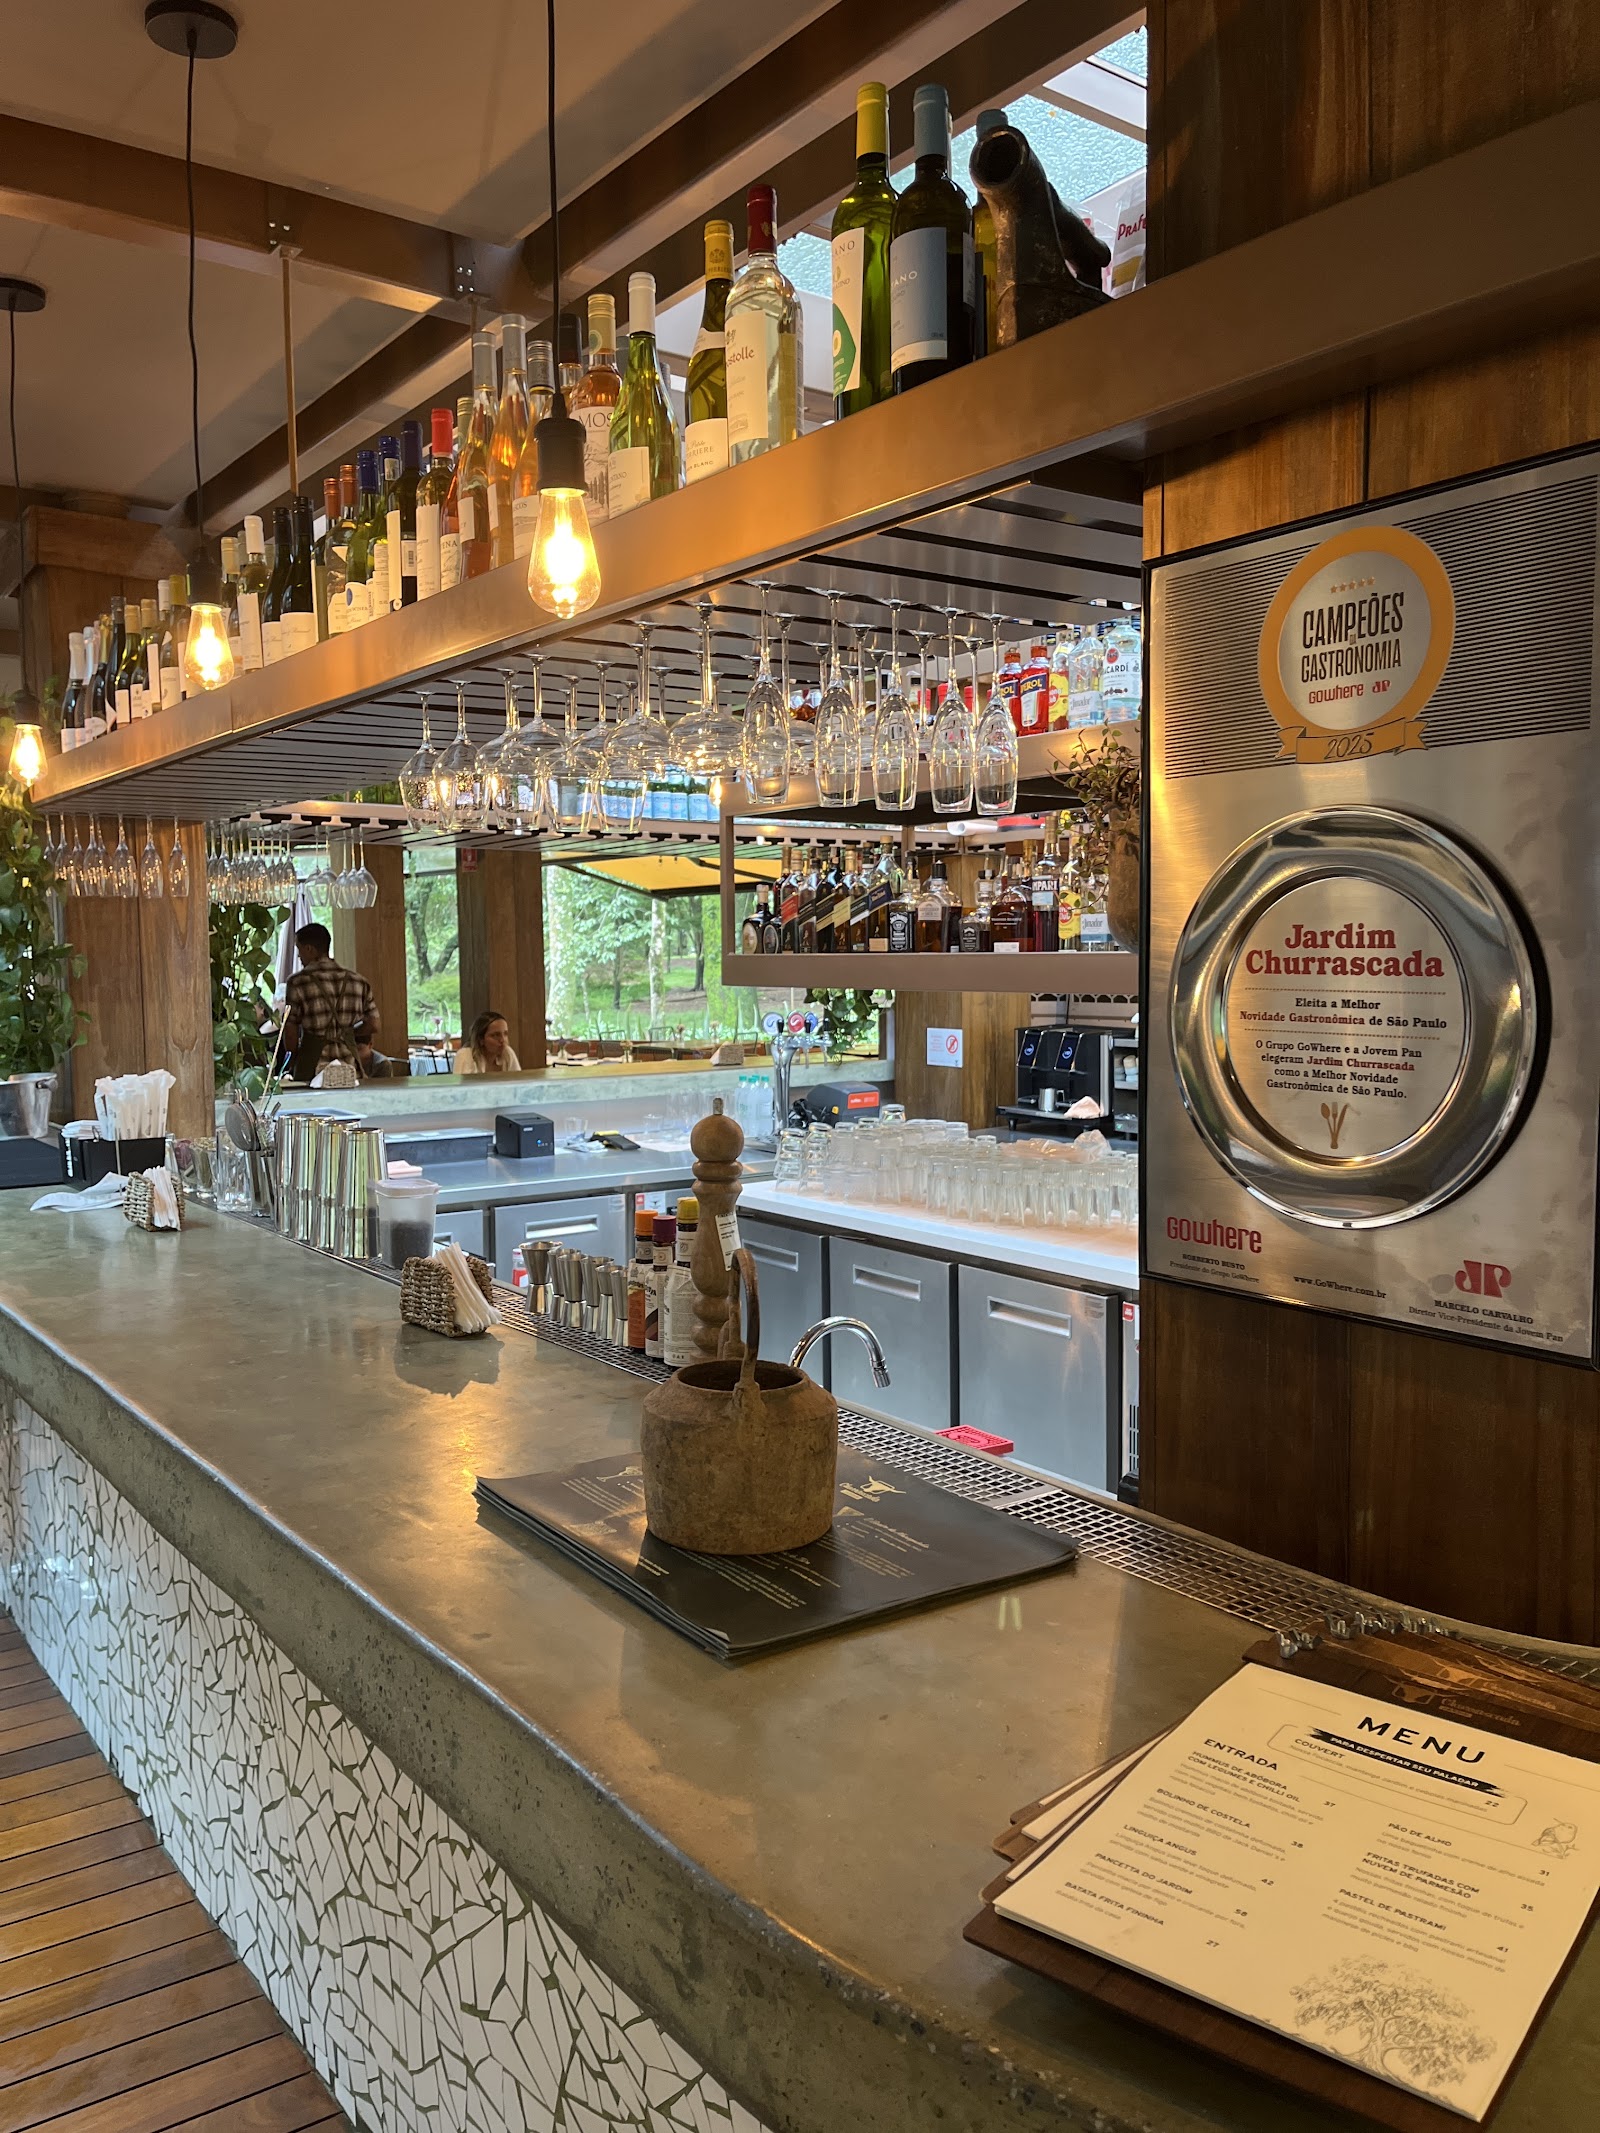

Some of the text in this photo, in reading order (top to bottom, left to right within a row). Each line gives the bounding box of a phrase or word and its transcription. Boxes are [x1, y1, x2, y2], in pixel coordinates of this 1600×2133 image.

[1302, 592, 1405, 649] CAMPEÕES
[1302, 639, 1402, 682] GASTRONOMIA
[1324, 732, 1375, 760] 2025
[1285, 923, 1396, 949] Jardim
[1246, 950, 1444, 976] Churrascada
[1295, 998, 1381, 1010] Eleita a Melhor
[1240, 1010, 1447, 1029] Novidade Gastronômica de São Paulo
[1256, 1040, 1263, 1048] O
[1266, 1040, 1294, 1051] Grupo
[1297, 1042, 1341, 1053] GoWhere
[1362, 1046, 1398, 1057] Jovem
[1402, 1048, 1422, 1058] Pan
[1261, 1054, 1415, 1071] elegeram Jardim Churrascada
[1266, 1079, 1407, 1098] Gastronômica de São Paulo.
[1274, 1069, 1300, 1077] como
[1312, 1069, 1346, 1080] Melhor
[1350, 1072, 1399, 1084] Novidade
[1221, 1260, 1246, 1270] BUSTO
[1293, 1276, 1387, 1299] www.GoWhere.com.br
[1409, 1306, 1564, 1342] Diretor Vice-Presidente da Jovem Pan
[1434, 1300, 1534, 1325] MARCELO CARVALHO
[1202, 1739, 1281, 1769] ENTRADA
[1293, 1739, 1345, 1758] COUVERT
[1358, 1718, 1484, 1763] MENU
[1191, 1751, 1230, 1767] HUMMUS
[1330, 1737, 1355, 1747] PARA
[1356, 1746, 1411, 1766] DESPERTAR
[1411, 1764, 1431, 1773] SEU
[1432, 1770, 1478, 1787] PALADAR
[1187, 1756, 1206, 1764] COM
[1207, 1764, 1248, 1780] LEGUMES
[1255, 1782, 1285, 1795] CHILLI
[1156, 1788, 1196, 1805] BOLINHO
[1209, 1809, 1252, 1827] COSTELA
[1122, 1824, 1164, 1843] LINGUIÇA
[1165, 1841, 1197, 1855] ANGUS
[1388, 1822, 1408, 1832] PÃO
[1423, 1834, 1452, 1846] ALHO
[1094, 1853, 1140, 1873] PANCETTA
[1155, 1877, 1192, 1894] JARDIM
[1362, 1857, 1397, 1873] NUVEM
[1415, 1875, 1472, 1899] PARMESÃO
[1366, 1851, 1534, 1911] FRITAS TRUFADAS COM 35
[1064, 1881, 1097, 1898] BATATA
[1098, 1895, 1125, 1909] FRITA
[1125, 1906, 1165, 1926] FININHA
[1206, 1940, 1219, 1948] 27
[1339, 1888, 1376, 1905] PASTEL
[1377, 1903, 1392, 1911] DE
[1393, 1908, 1446, 1931] PASTRAMI
